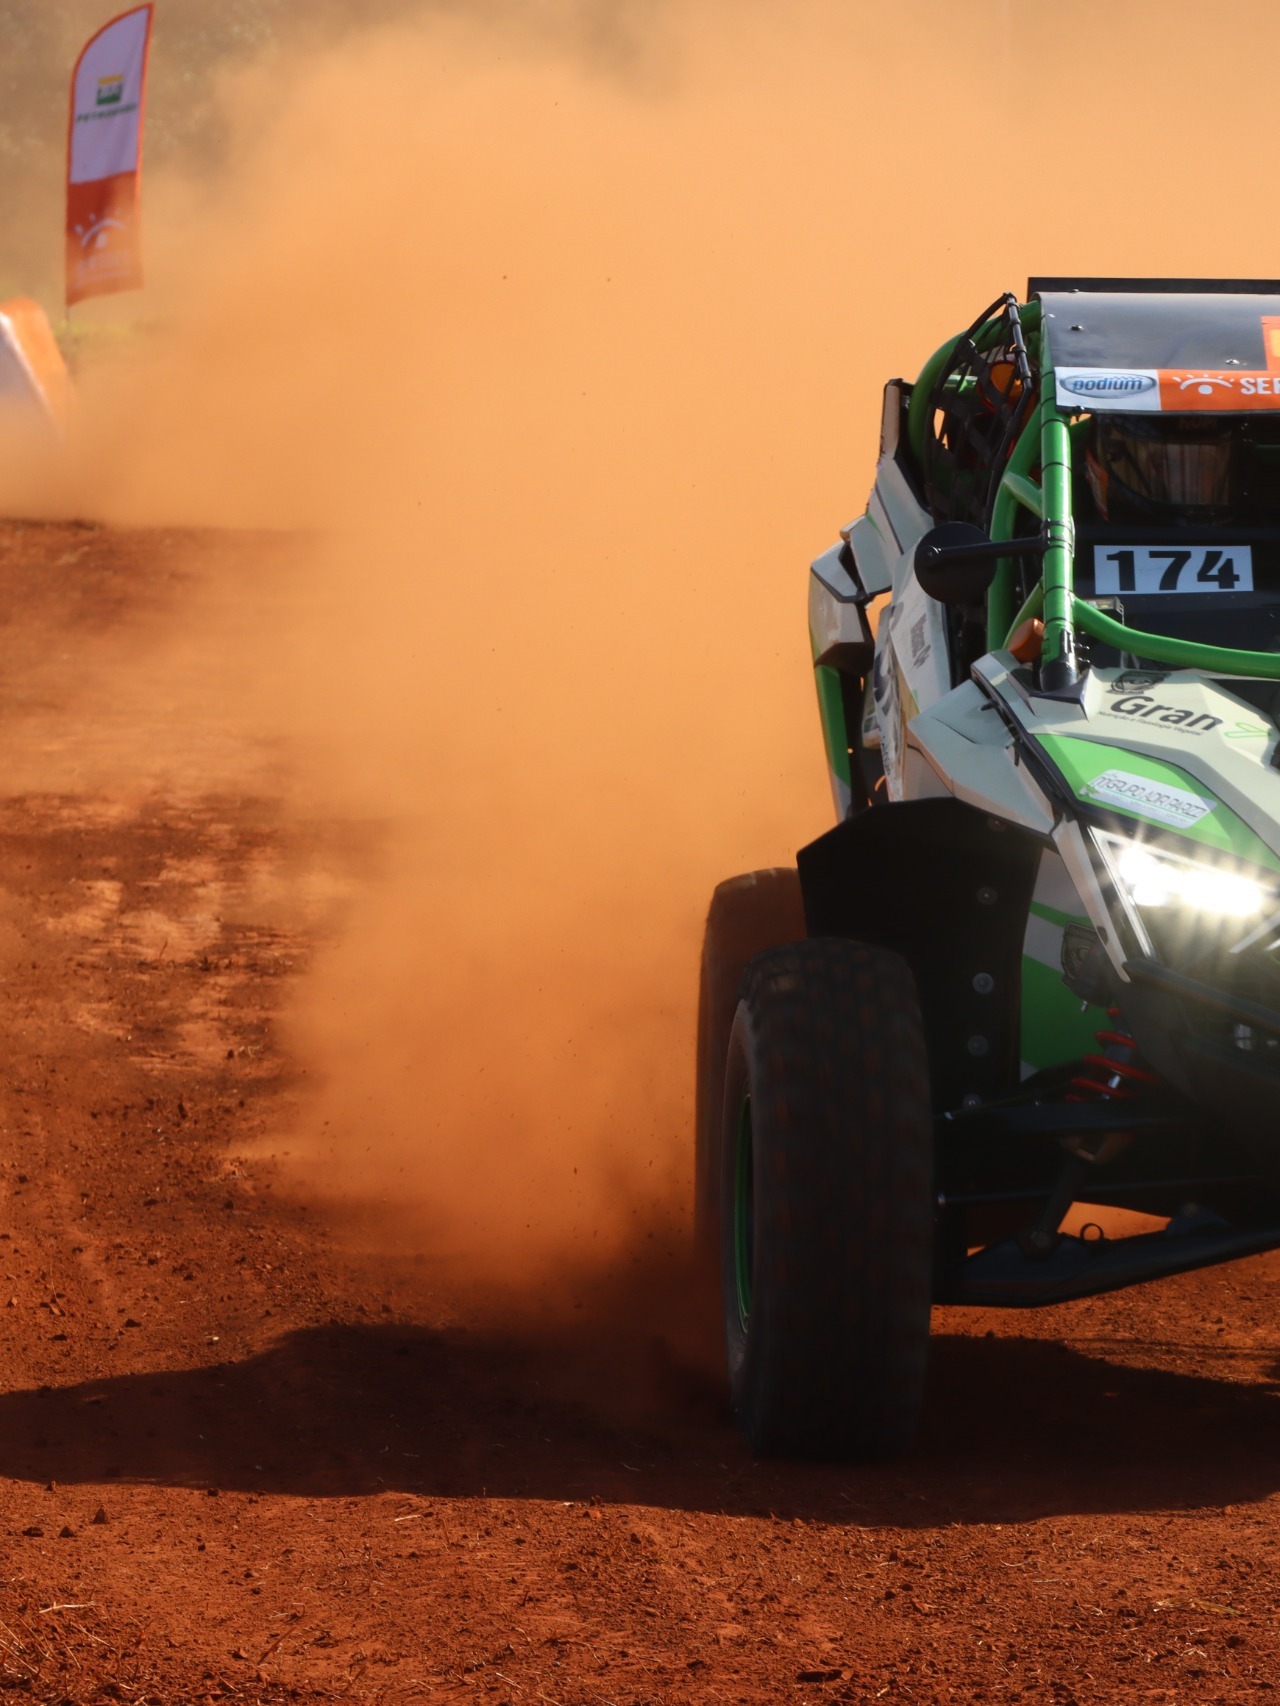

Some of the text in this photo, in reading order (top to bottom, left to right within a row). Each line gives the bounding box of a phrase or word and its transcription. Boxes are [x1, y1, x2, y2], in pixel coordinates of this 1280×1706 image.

[1072, 377, 1143, 391] podium
[1106, 550, 1240, 591] 174
[1110, 695, 1223, 731] Gran
